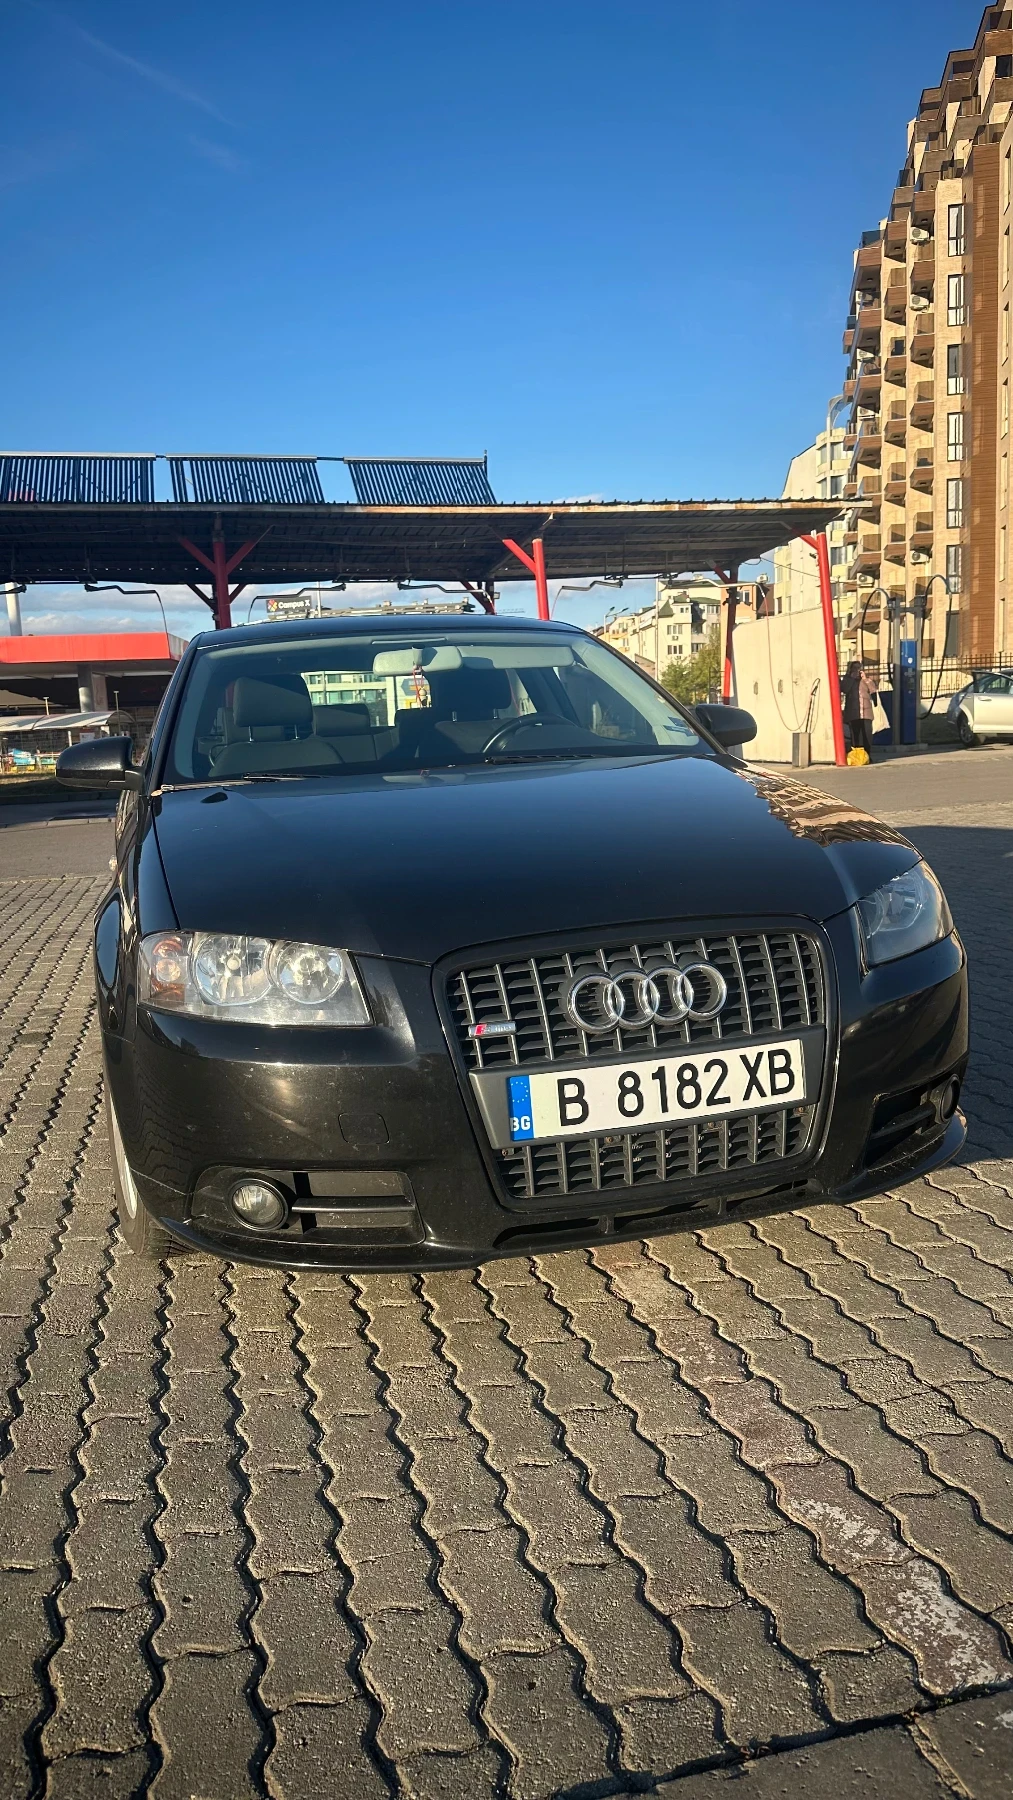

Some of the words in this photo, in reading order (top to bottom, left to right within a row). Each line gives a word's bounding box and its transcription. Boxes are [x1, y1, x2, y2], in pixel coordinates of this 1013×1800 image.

[278, 601, 304, 609] Campus
[557, 1078, 589, 1126] B
[617, 1058, 731, 1117] 8182
[739, 1049, 795, 1101] XB
[510, 1116, 531, 1131] BG
